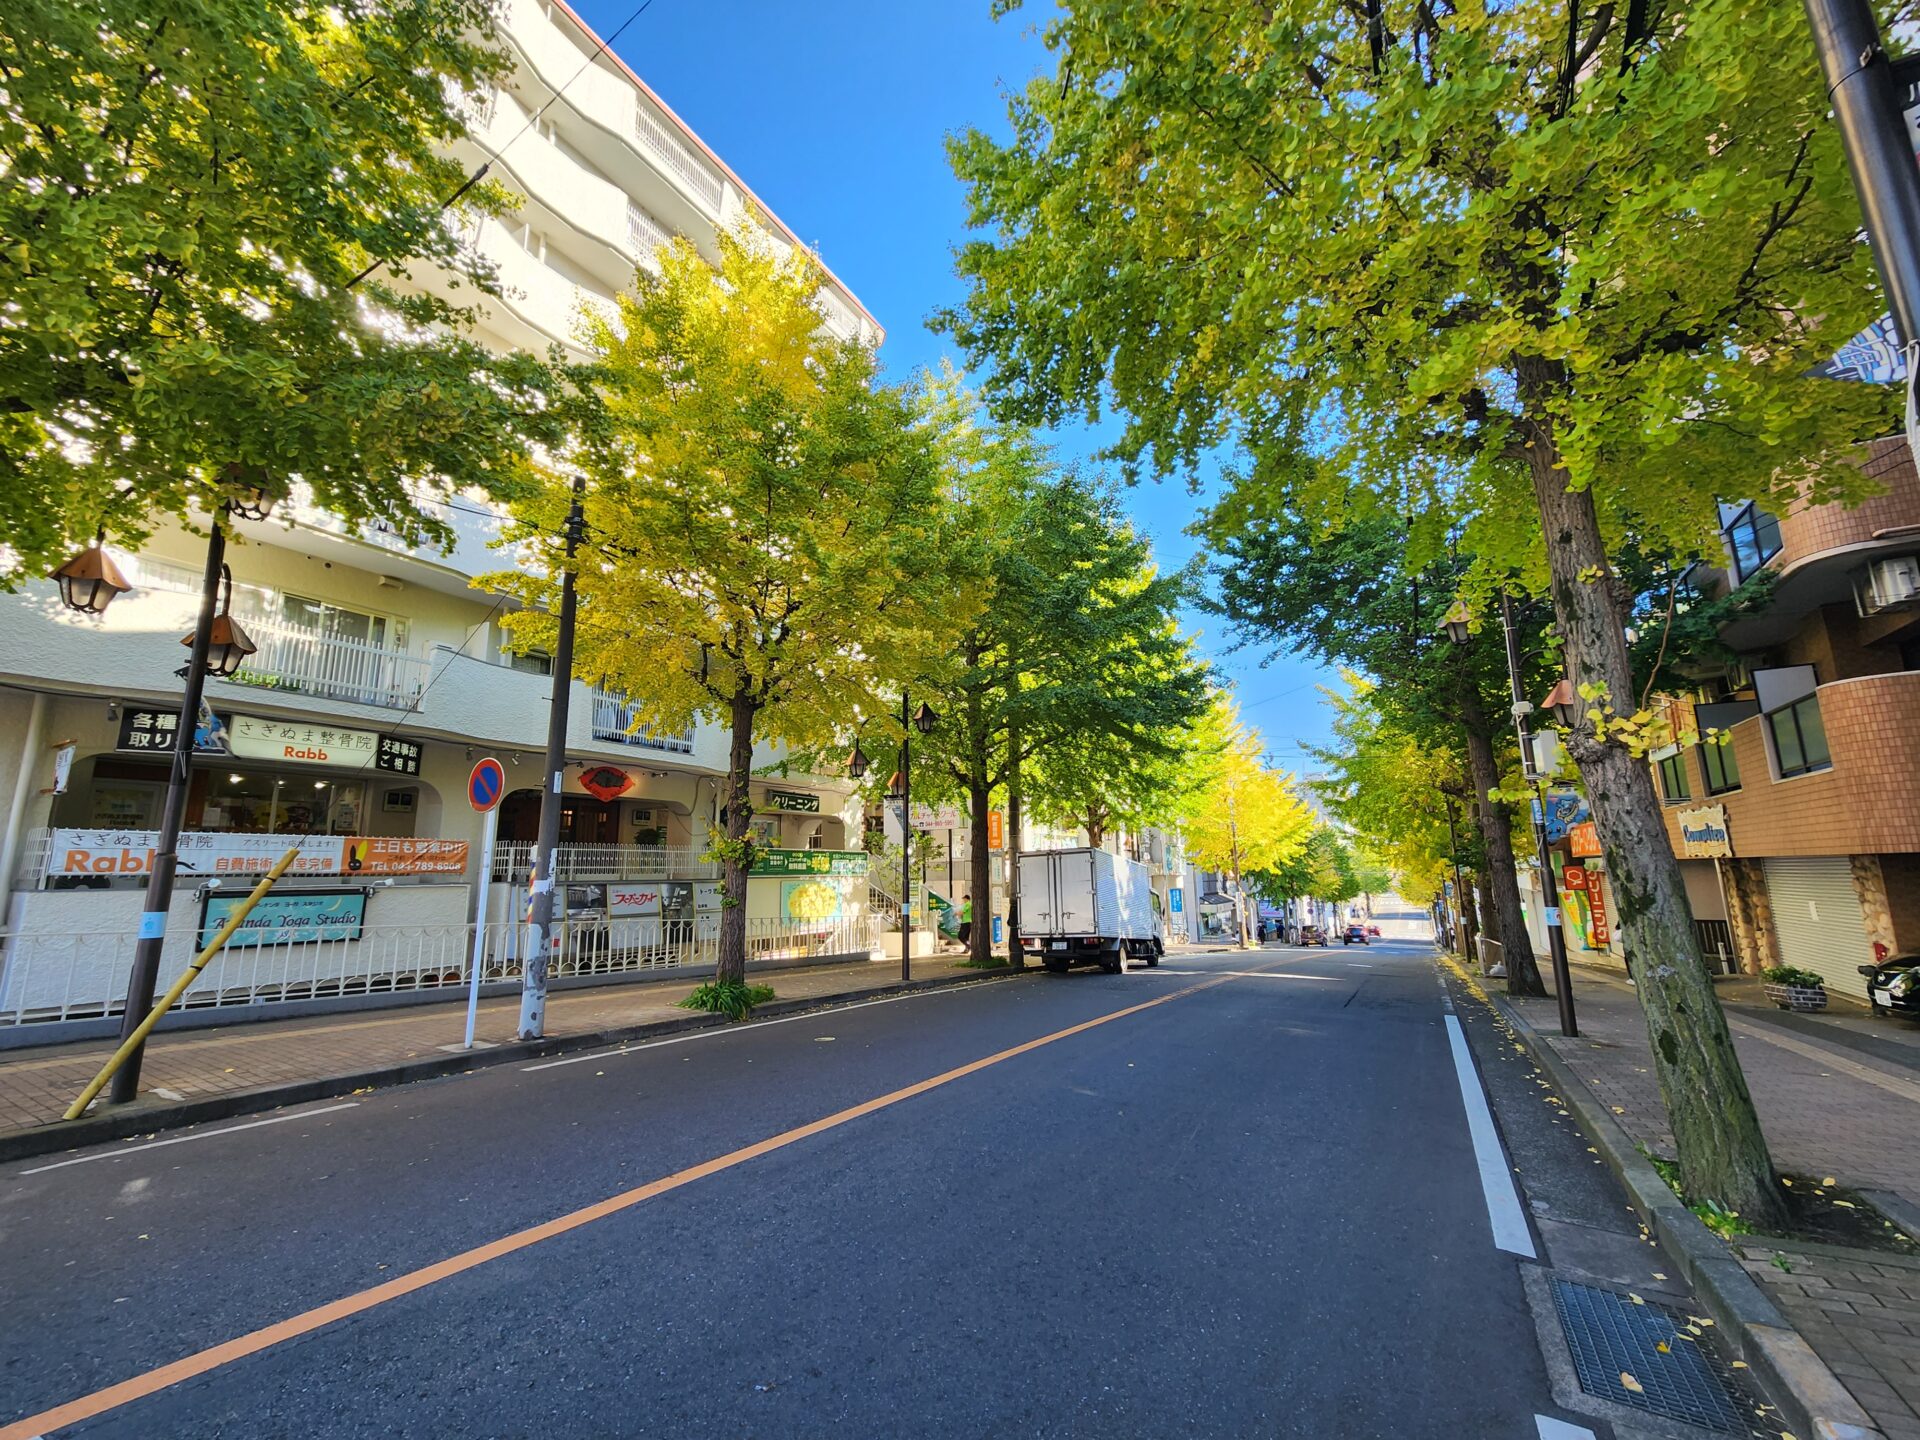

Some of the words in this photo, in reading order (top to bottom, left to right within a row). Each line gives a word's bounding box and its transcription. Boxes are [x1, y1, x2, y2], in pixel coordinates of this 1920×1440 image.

[239, 721, 372, 750] さぎぬま整骨院
[284, 745, 328, 761] Rabb
[381, 738, 417, 758] 交通事故
[380, 755, 416, 774] ご相談
[771, 795, 818, 811] クリーニング
[71, 833, 213, 849] さぎぬま骨院
[371, 861, 389, 871] TEL
[611, 892, 657, 906] スーパーカット
[277, 914, 309, 929] Yoga
[316, 911, 357, 925] Studio
